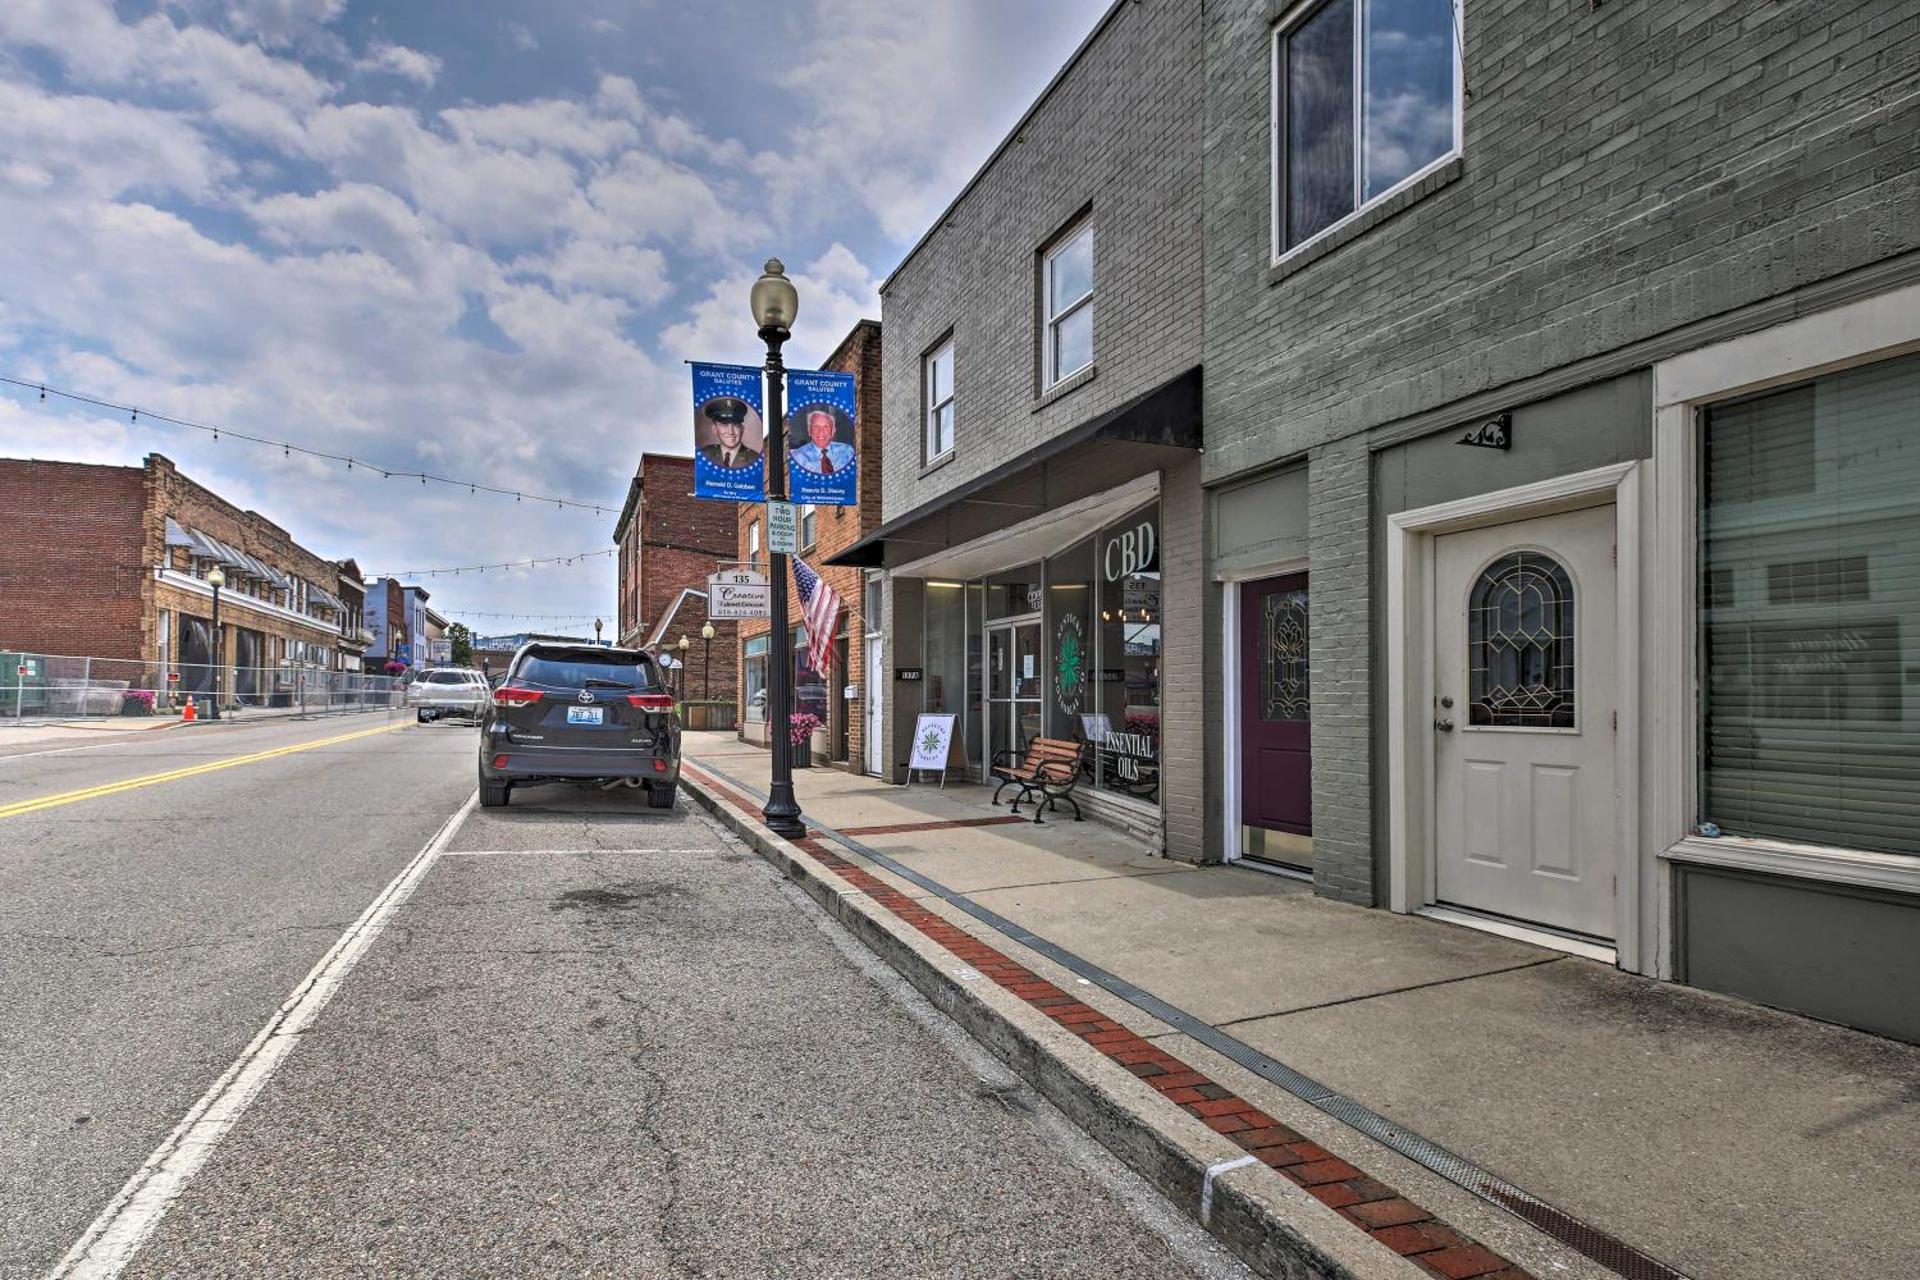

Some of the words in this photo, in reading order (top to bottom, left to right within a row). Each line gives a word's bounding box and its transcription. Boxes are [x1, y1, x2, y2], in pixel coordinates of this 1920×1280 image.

[700, 370, 724, 378] GRANT
[726, 373, 755, 381] COUNTY
[713, 378, 742, 386] SALUTES
[794, 379, 819, 387] GRANT
[775, 507, 791, 516] TWO
[773, 515, 792, 523] HOUR
[770, 523, 795, 532] PARKING
[1105, 521, 1154, 582] CBD
[733, 575, 750, 584] 135
[719, 586, 765, 601] Creative
[1106, 731, 1154, 759] ESSENTIAL
[1117, 756, 1139, 781] OILS
